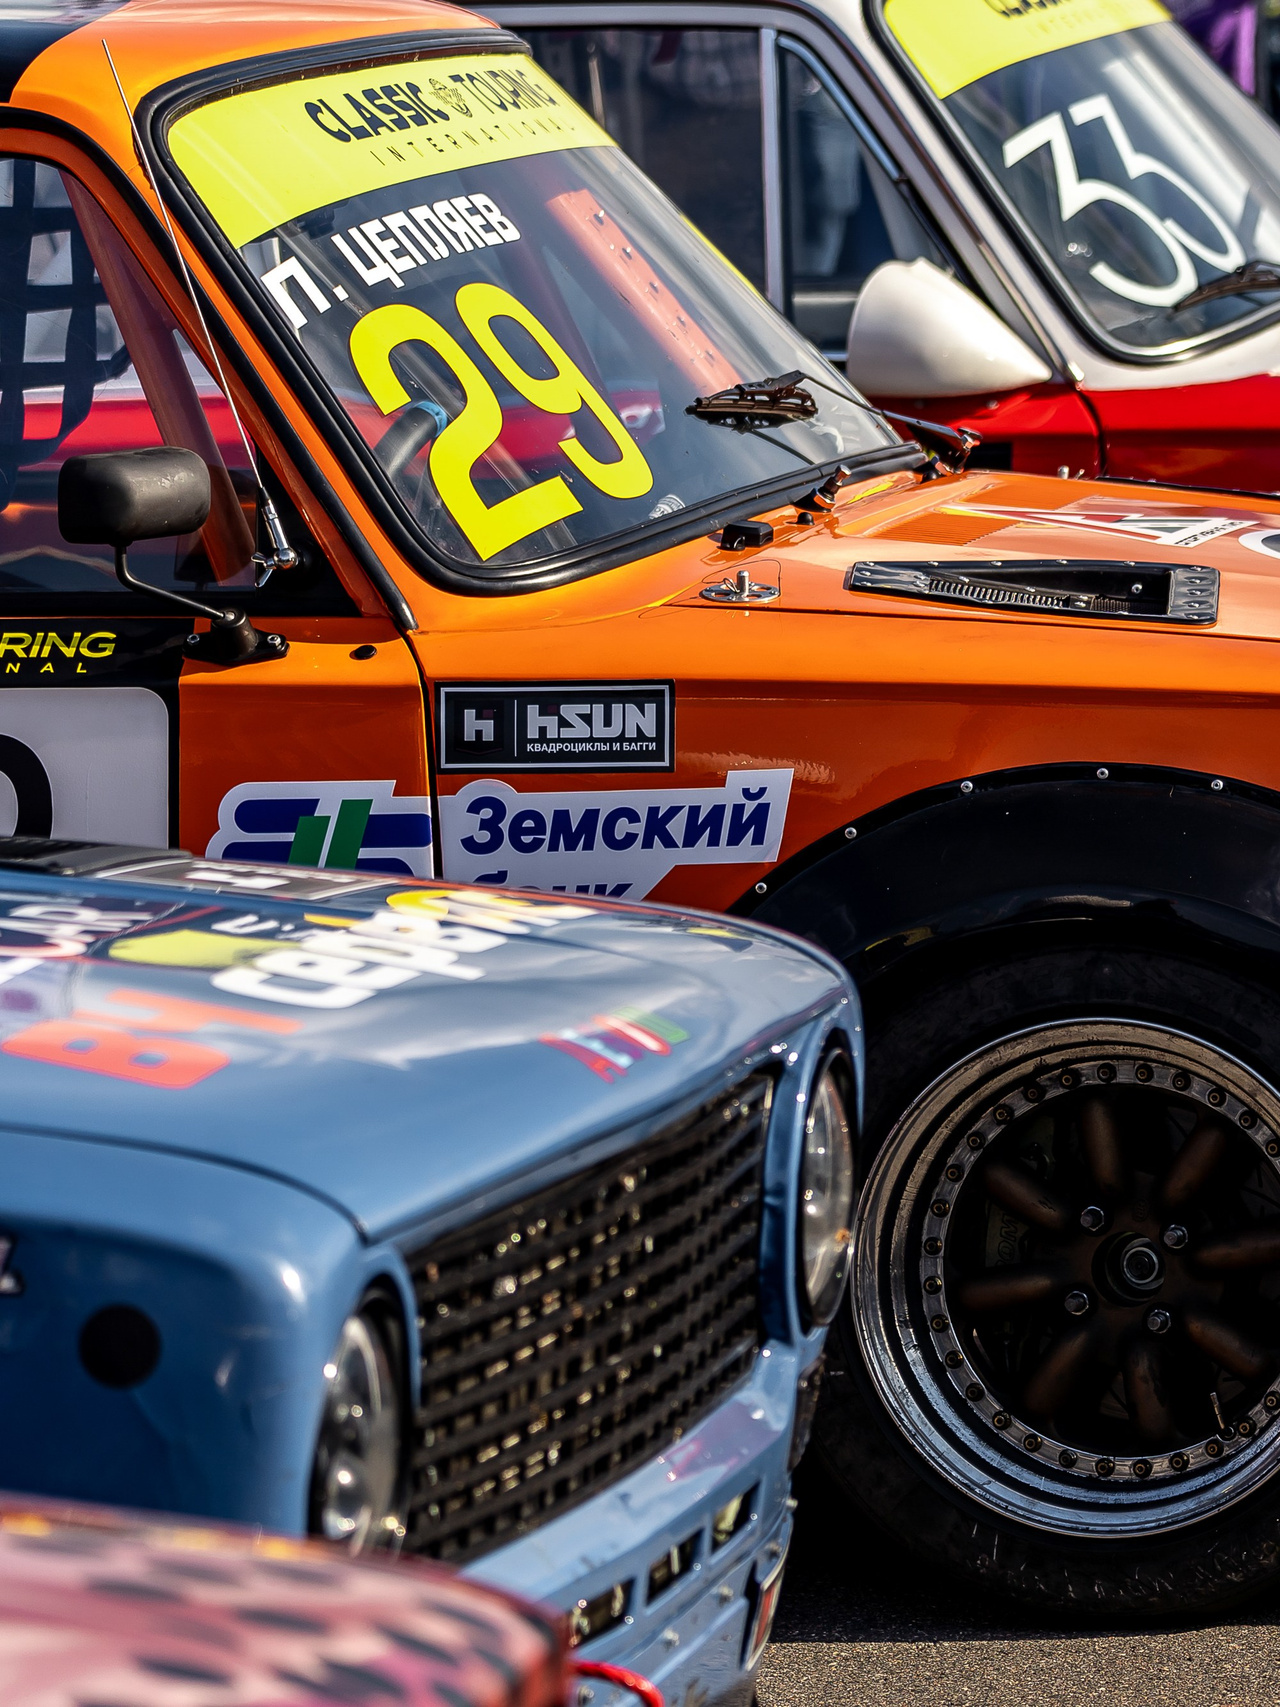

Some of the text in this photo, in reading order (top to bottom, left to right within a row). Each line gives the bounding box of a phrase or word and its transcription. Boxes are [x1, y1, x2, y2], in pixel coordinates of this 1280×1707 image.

[304, 69, 560, 143] CLASSIC TOURING
[1002, 94, 1246, 307] 33
[260, 193, 521, 330] П. ЦЕПЛЯЕВ
[349, 282, 654, 561] 29
[527, 741, 657, 754] КВАДРОЦИКЛЫ И БАГГИ
[460, 786, 771, 855] Земский
